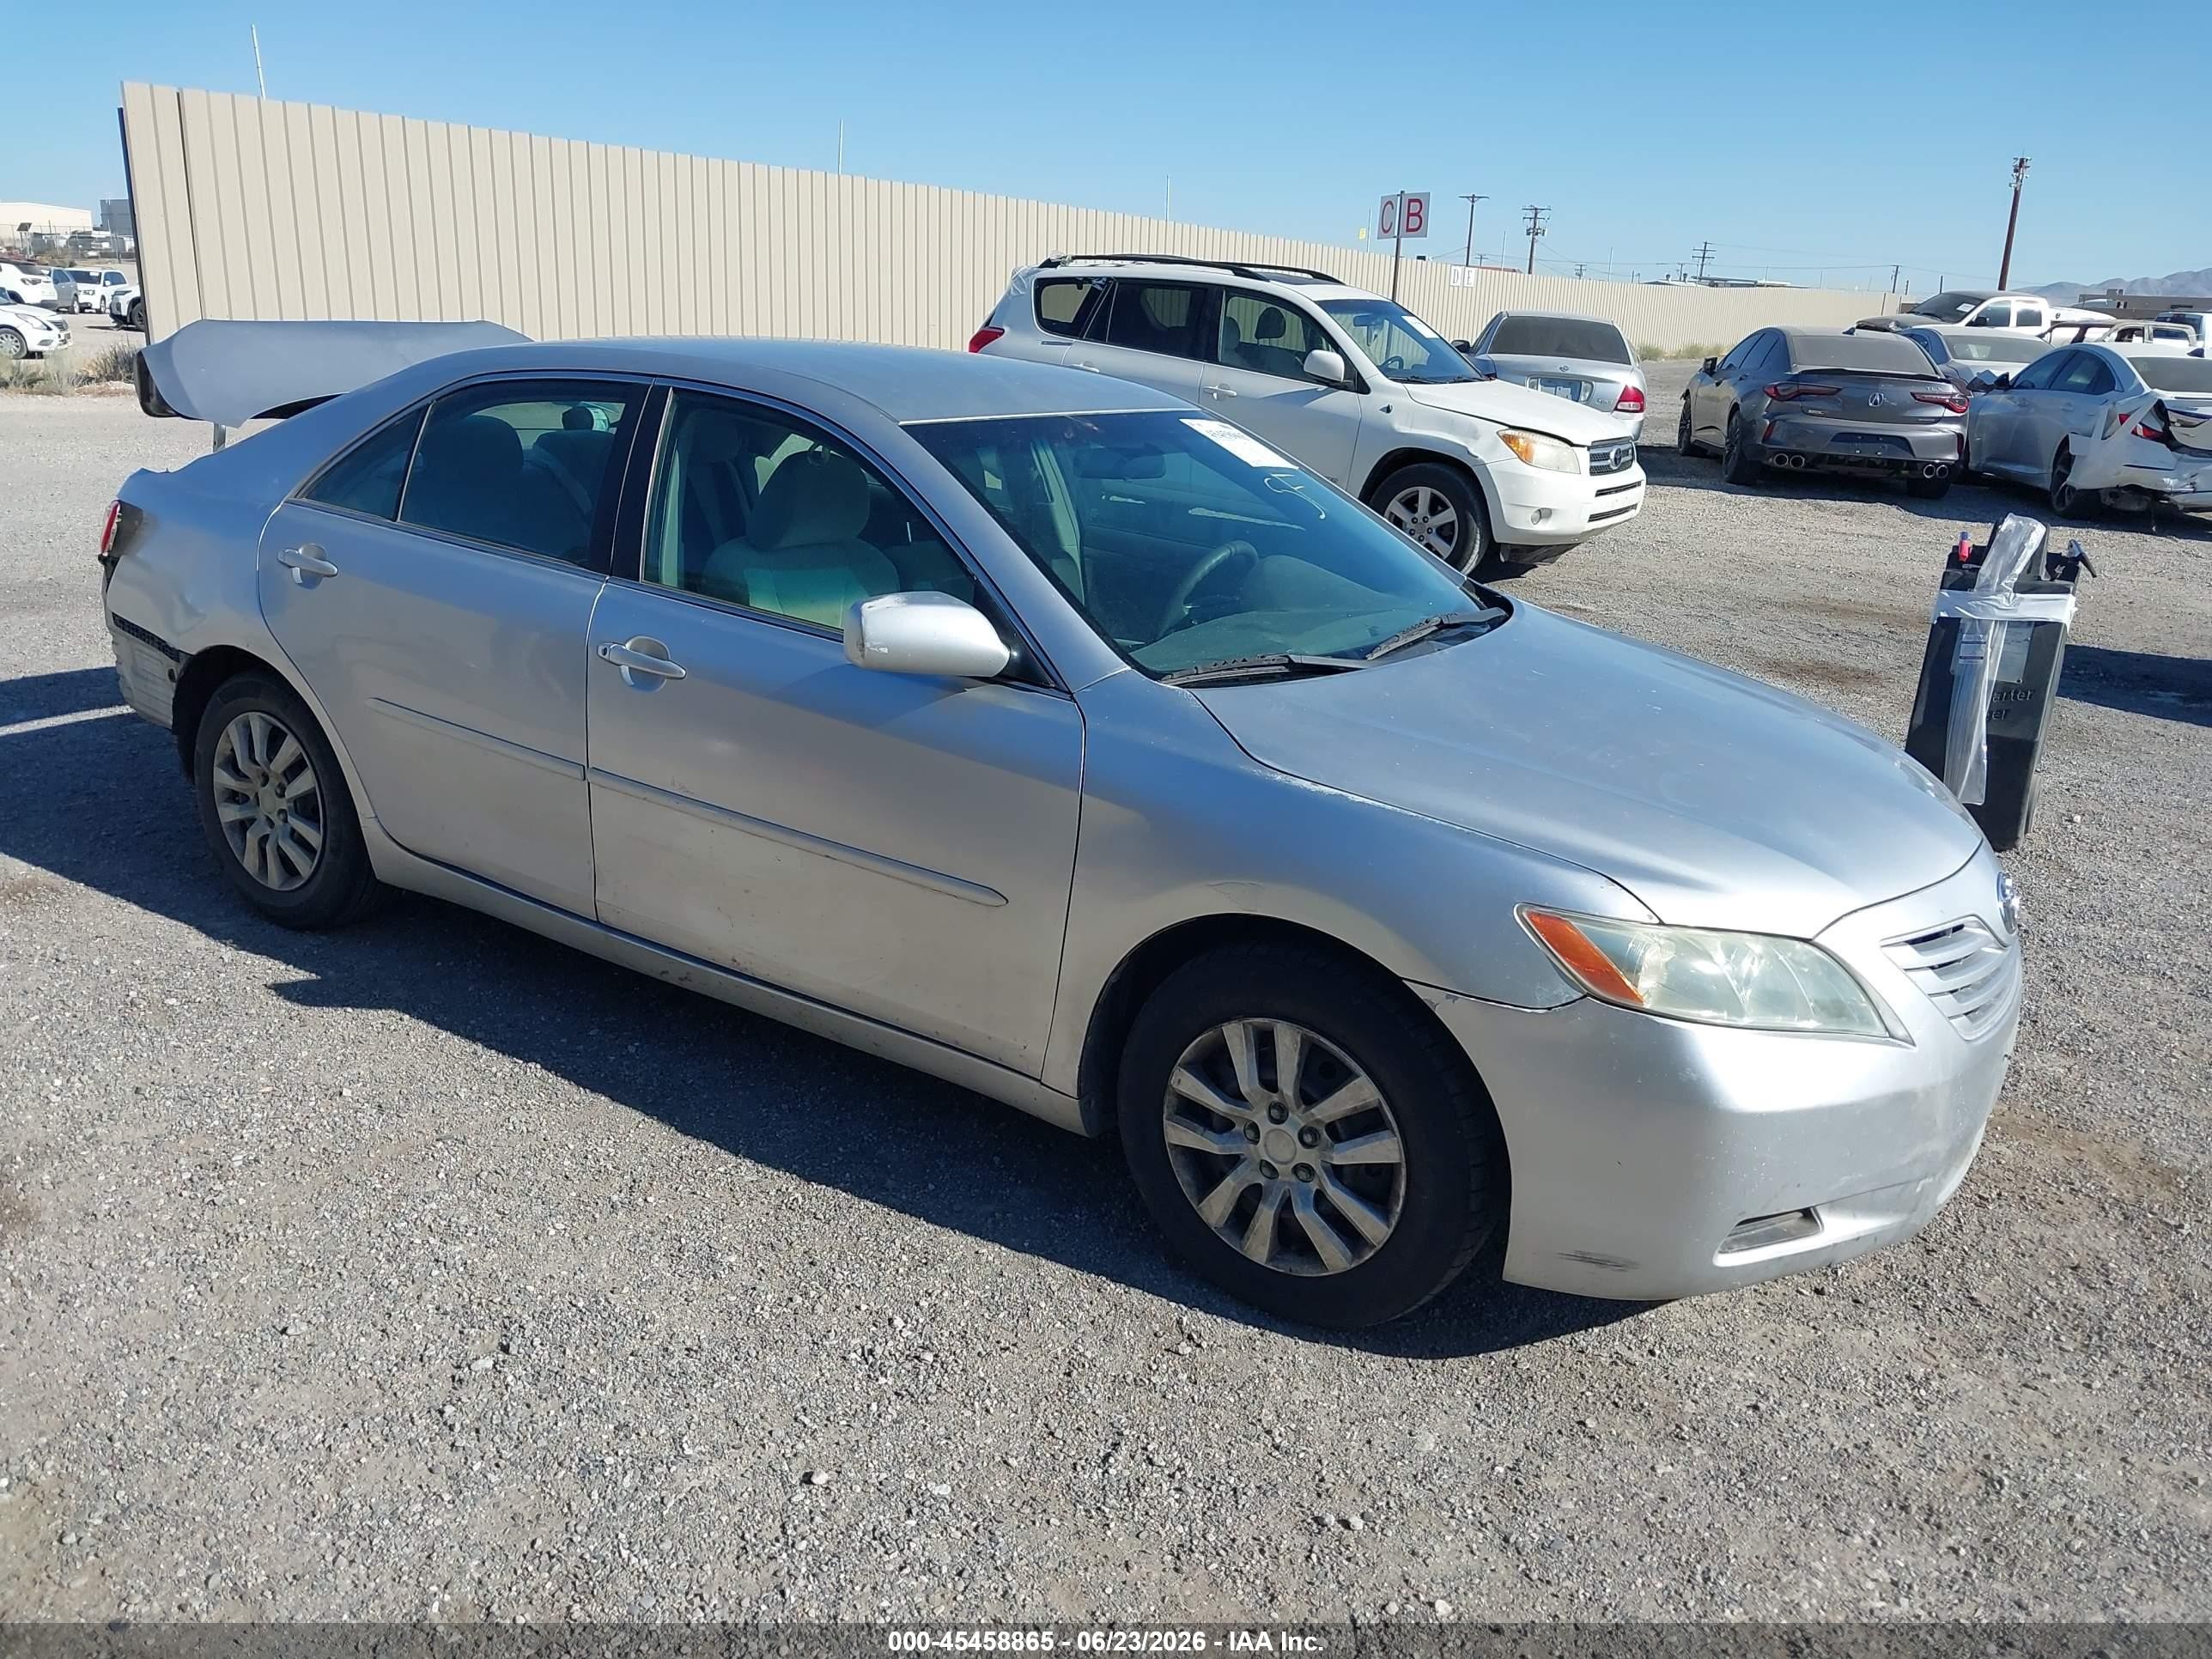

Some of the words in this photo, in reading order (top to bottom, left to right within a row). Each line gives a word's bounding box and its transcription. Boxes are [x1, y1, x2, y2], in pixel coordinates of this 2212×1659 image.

[1381, 200, 1395, 234] C
[1406, 198, 1423, 233] B
[1452, 268, 1460, 284] D
